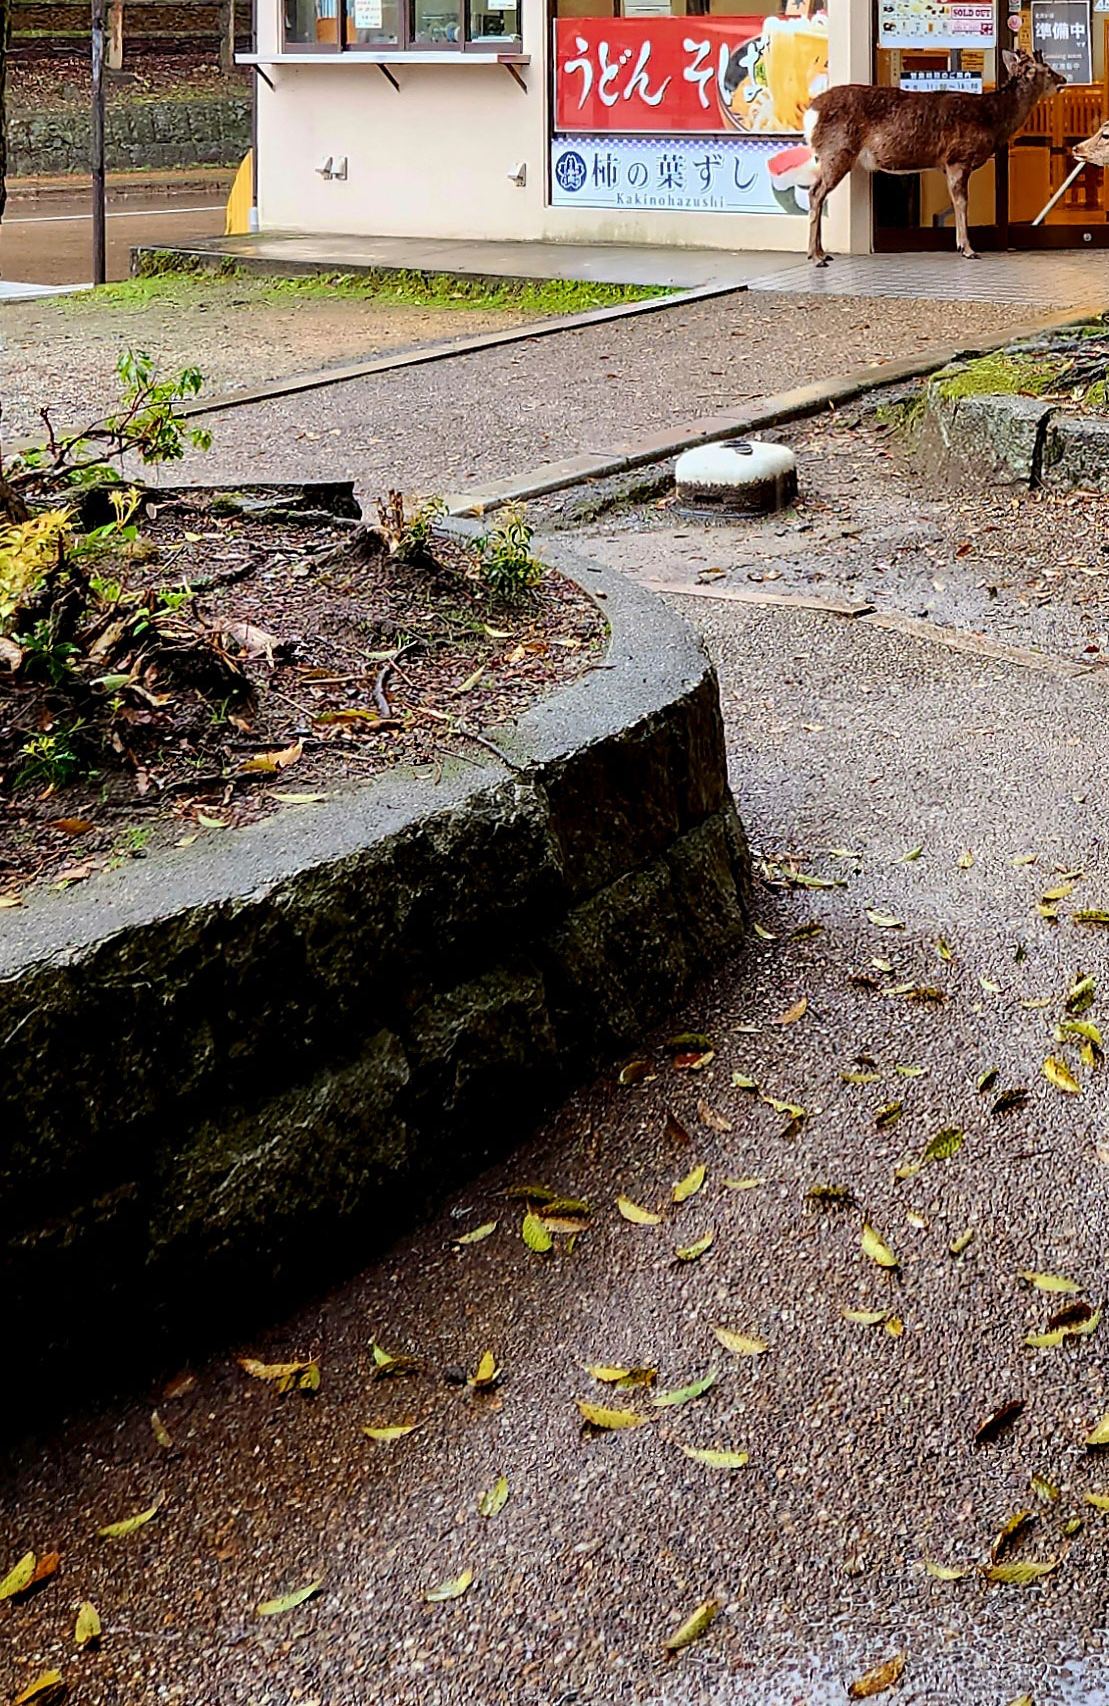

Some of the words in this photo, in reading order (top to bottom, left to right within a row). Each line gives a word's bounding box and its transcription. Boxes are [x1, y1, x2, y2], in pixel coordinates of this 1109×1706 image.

[1035, 22, 1086, 40] 準備中
[564, 37, 672, 110] うどん
[683, 38, 771, 109] そば
[592, 152, 758, 191] 柿の葉ずし
[616, 192, 725, 208] Kakinohazushi
